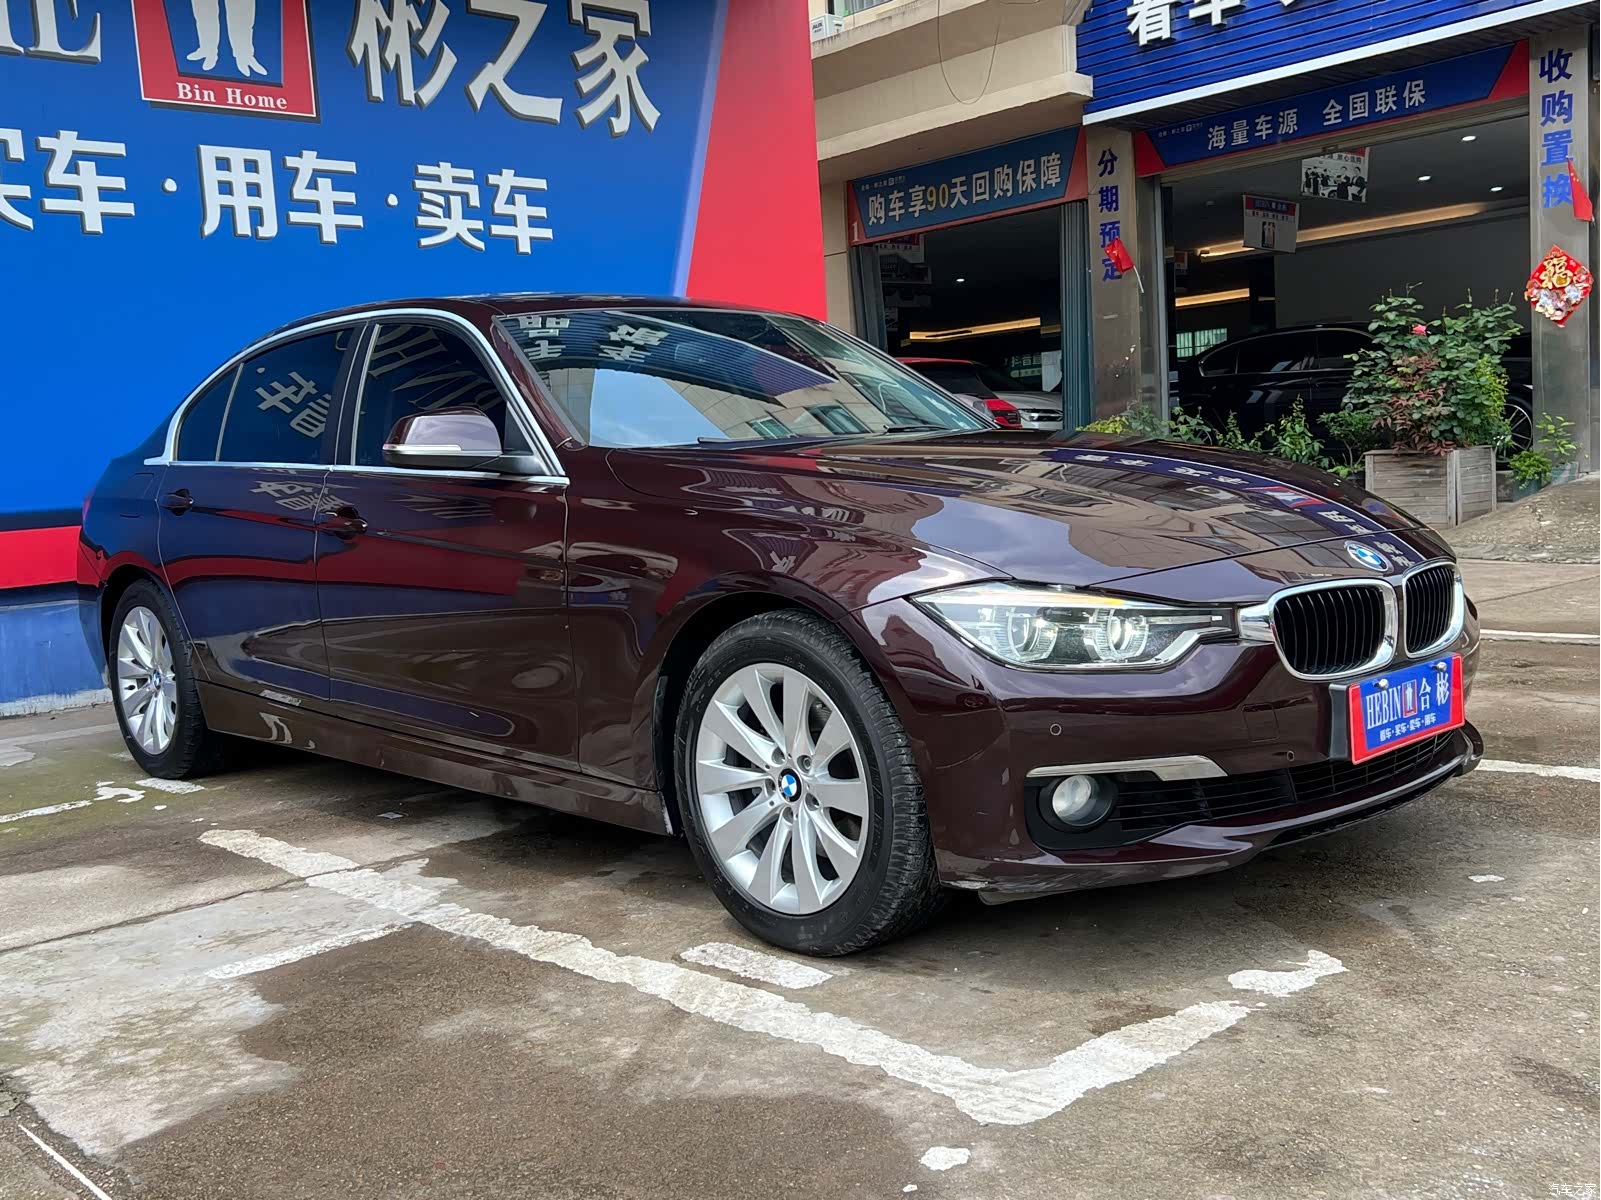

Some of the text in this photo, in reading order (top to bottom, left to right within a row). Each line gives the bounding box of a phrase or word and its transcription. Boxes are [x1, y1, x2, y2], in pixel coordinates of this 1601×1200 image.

[175, 81, 288, 109] Bin Home
[1207, 79, 1427, 151] 海量车源 全国联保
[1539, 47, 1575, 208] 收购置换
[868, 152, 1062, 226] 购车享90天回购保障
[1366, 671, 1450, 730] HEBIN 合彬
